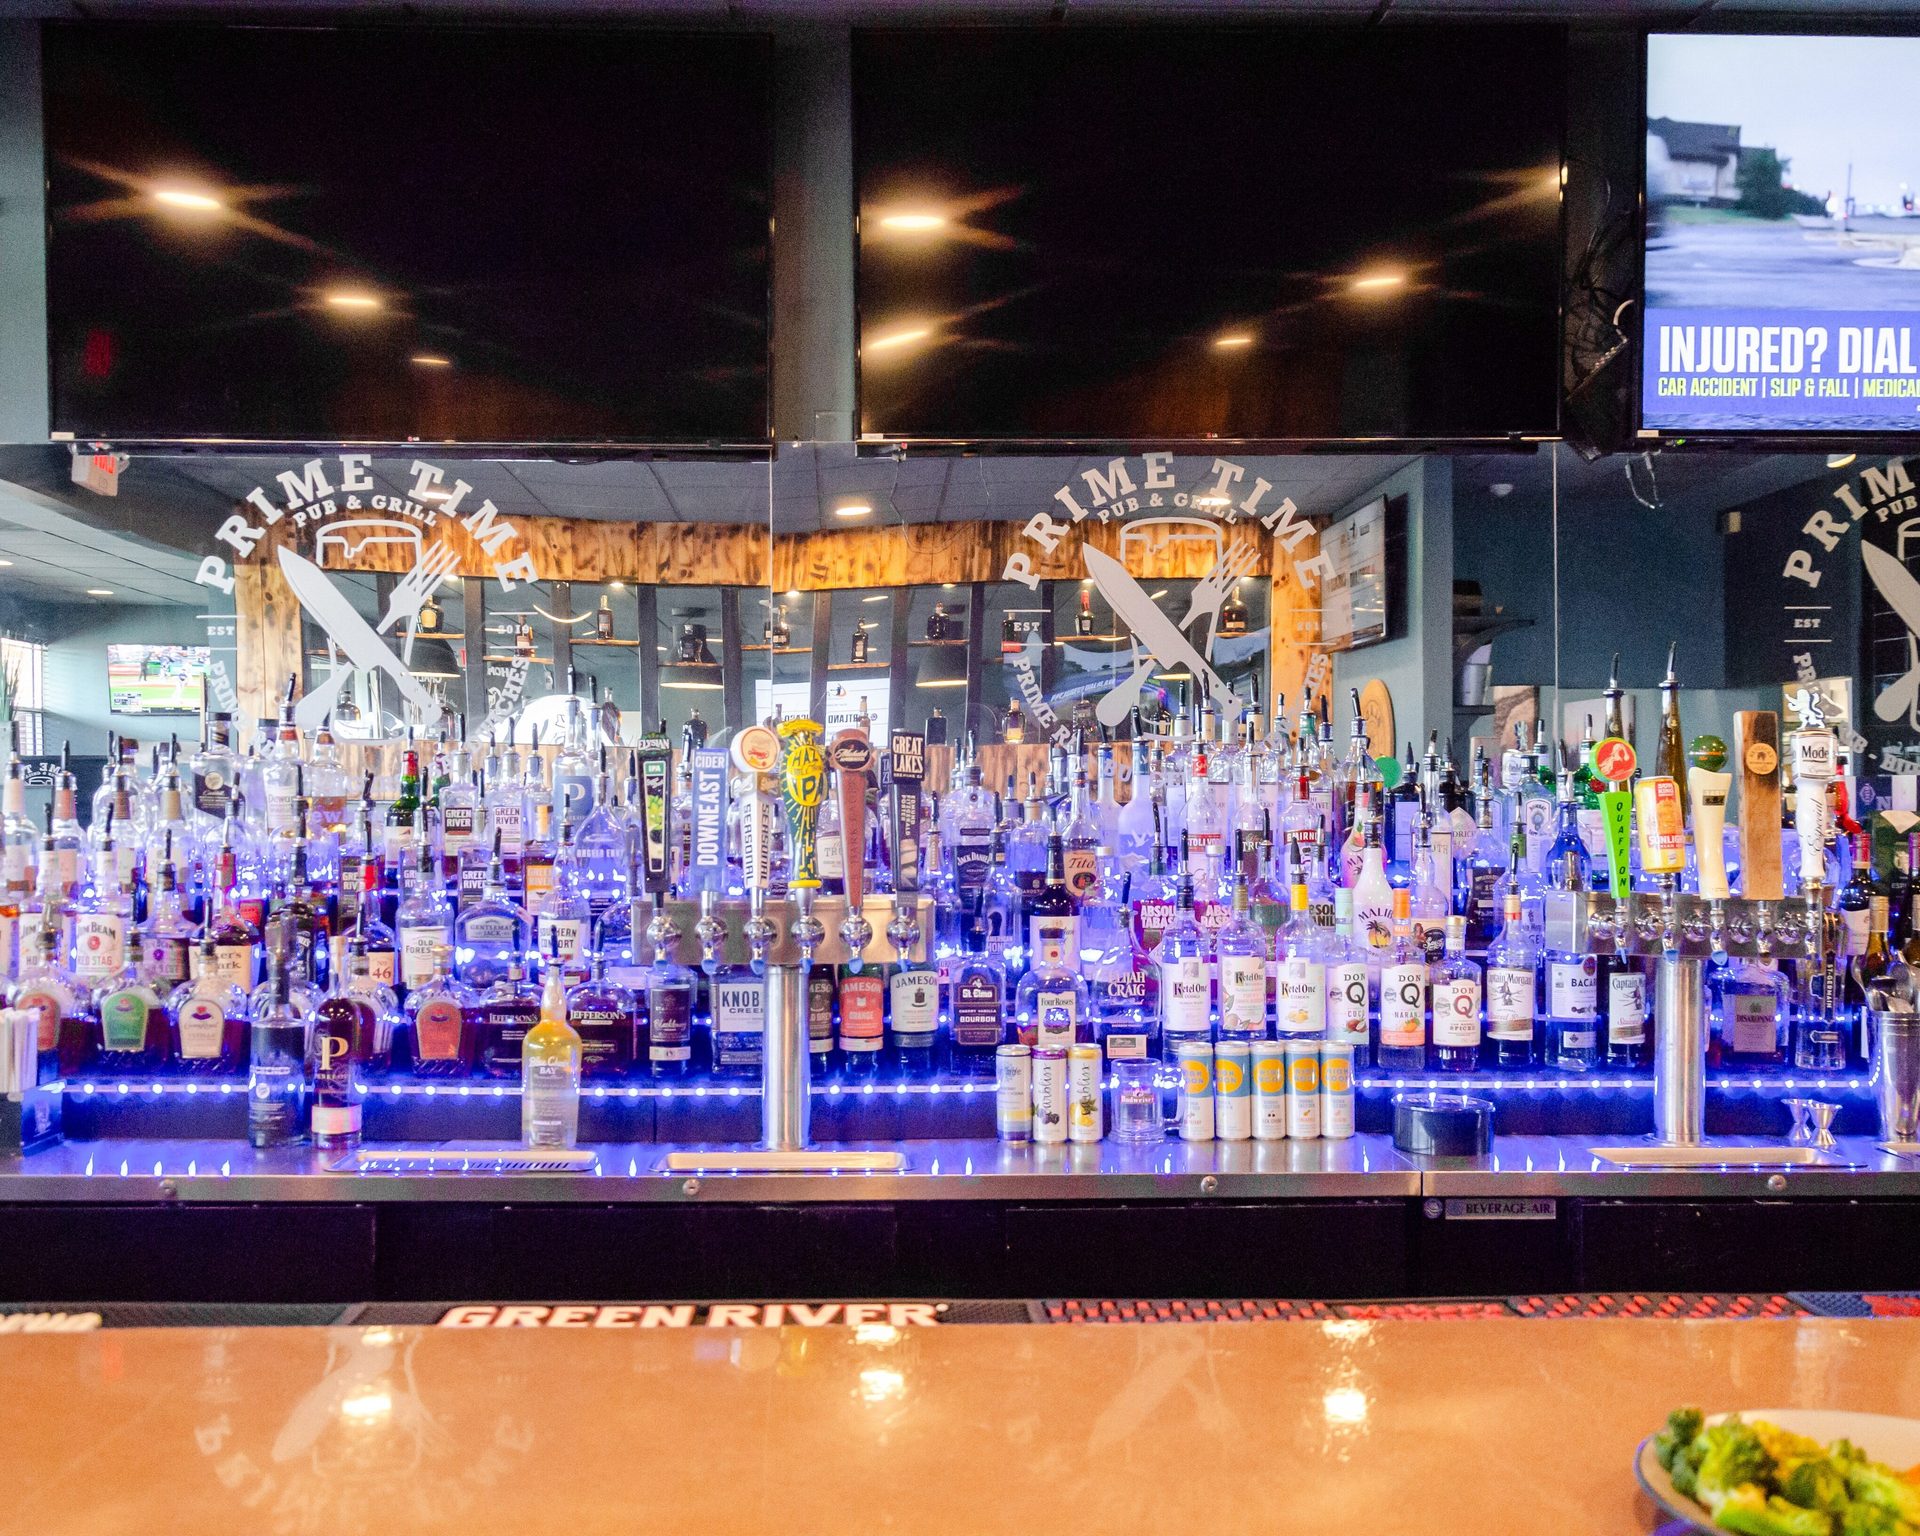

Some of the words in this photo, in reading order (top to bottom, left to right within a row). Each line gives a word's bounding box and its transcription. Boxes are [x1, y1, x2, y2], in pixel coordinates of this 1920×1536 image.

[1659, 326, 1828, 374] INJURED?
[1838, 326, 1917, 374] DIAL
[1657, 377, 1687, 396] CAR
[1690, 377, 1758, 397] ACCIDENT
[1770, 378, 1801, 397] SLIP
[1804, 379, 1815, 396] &
[1818, 378, 1850, 397] FALL
[292, 501, 337, 528] PUB
[346, 494, 362, 511] &
[371, 494, 437, 527] GRILL
[1097, 497, 1139, 525] PUB
[1149, 492, 1164, 507] &
[1174, 492, 1238, 525] GRILL
[1875, 496, 1918, 523] PUB
[195, 453, 374, 595] PRIME
[408, 459, 539, 593] TIME
[1002, 451, 1175, 591] PRIME
[1210, 458, 1339, 589] TIME
[1782, 456, 1917, 588] PRIM
[1013, 621, 1041, 632] EST
[1793, 618, 1821, 628] EST
[207, 626, 235, 636] EST
[1012, 655, 1058, 729] PRIME
[893, 735, 924, 754] GREAT
[695, 755, 725, 769] CIDER
[893, 755, 924, 774] LAKES
[445, 809, 472, 818] GREEN
[495, 807, 520, 816] GREEN
[697, 771, 721, 866] DOWNEAST
[446, 818, 472, 827] RIVER
[496, 816, 519, 825] RIVER
[1616, 801, 1625, 857] QUAFF
[743, 803, 754, 888] SEASONAL
[759, 803, 770, 884] SEASONAL
[1619, 866, 1627, 887] ON
[463, 880, 485, 889] RIVE
[91, 921, 116, 940] BEAM
[540, 927, 577, 937] SOUHERN
[406, 945, 431, 954] FORES
[540, 939, 574, 949] COMORT
[91, 955, 113, 966] STAG
[372, 967, 392, 979] 46
[1235, 971, 1253, 984] Ketel
[1344, 973, 1366, 981] DON
[1398, 974, 1421, 982] DON
[895, 975, 938, 989] JAMESON
[1107, 983, 1146, 998] CRAIG
[1174, 983, 1195, 996] Ketel
[1281, 983, 1301, 996] Ketel
[1345, 981, 1366, 1007] Q
[1400, 982, 1420, 1008] Q
[722, 990, 760, 1007] KNOB
[1041, 997, 1055, 1006] Four
[1055, 997, 1074, 1006] Roses
[1453, 994, 1474, 1019] Q
[569, 1009, 627, 1021] JEFFERSON'S
[960, 1015, 996, 1023] BOURBON
[319, 1036, 349, 1071] P
[540, 1066, 557, 1075] BAY
[1465, 1203, 1550, 1214] BEVERAGE-AIR
[436, 1304, 697, 1328] GREEN
[702, 1303, 941, 1328] RIVER
